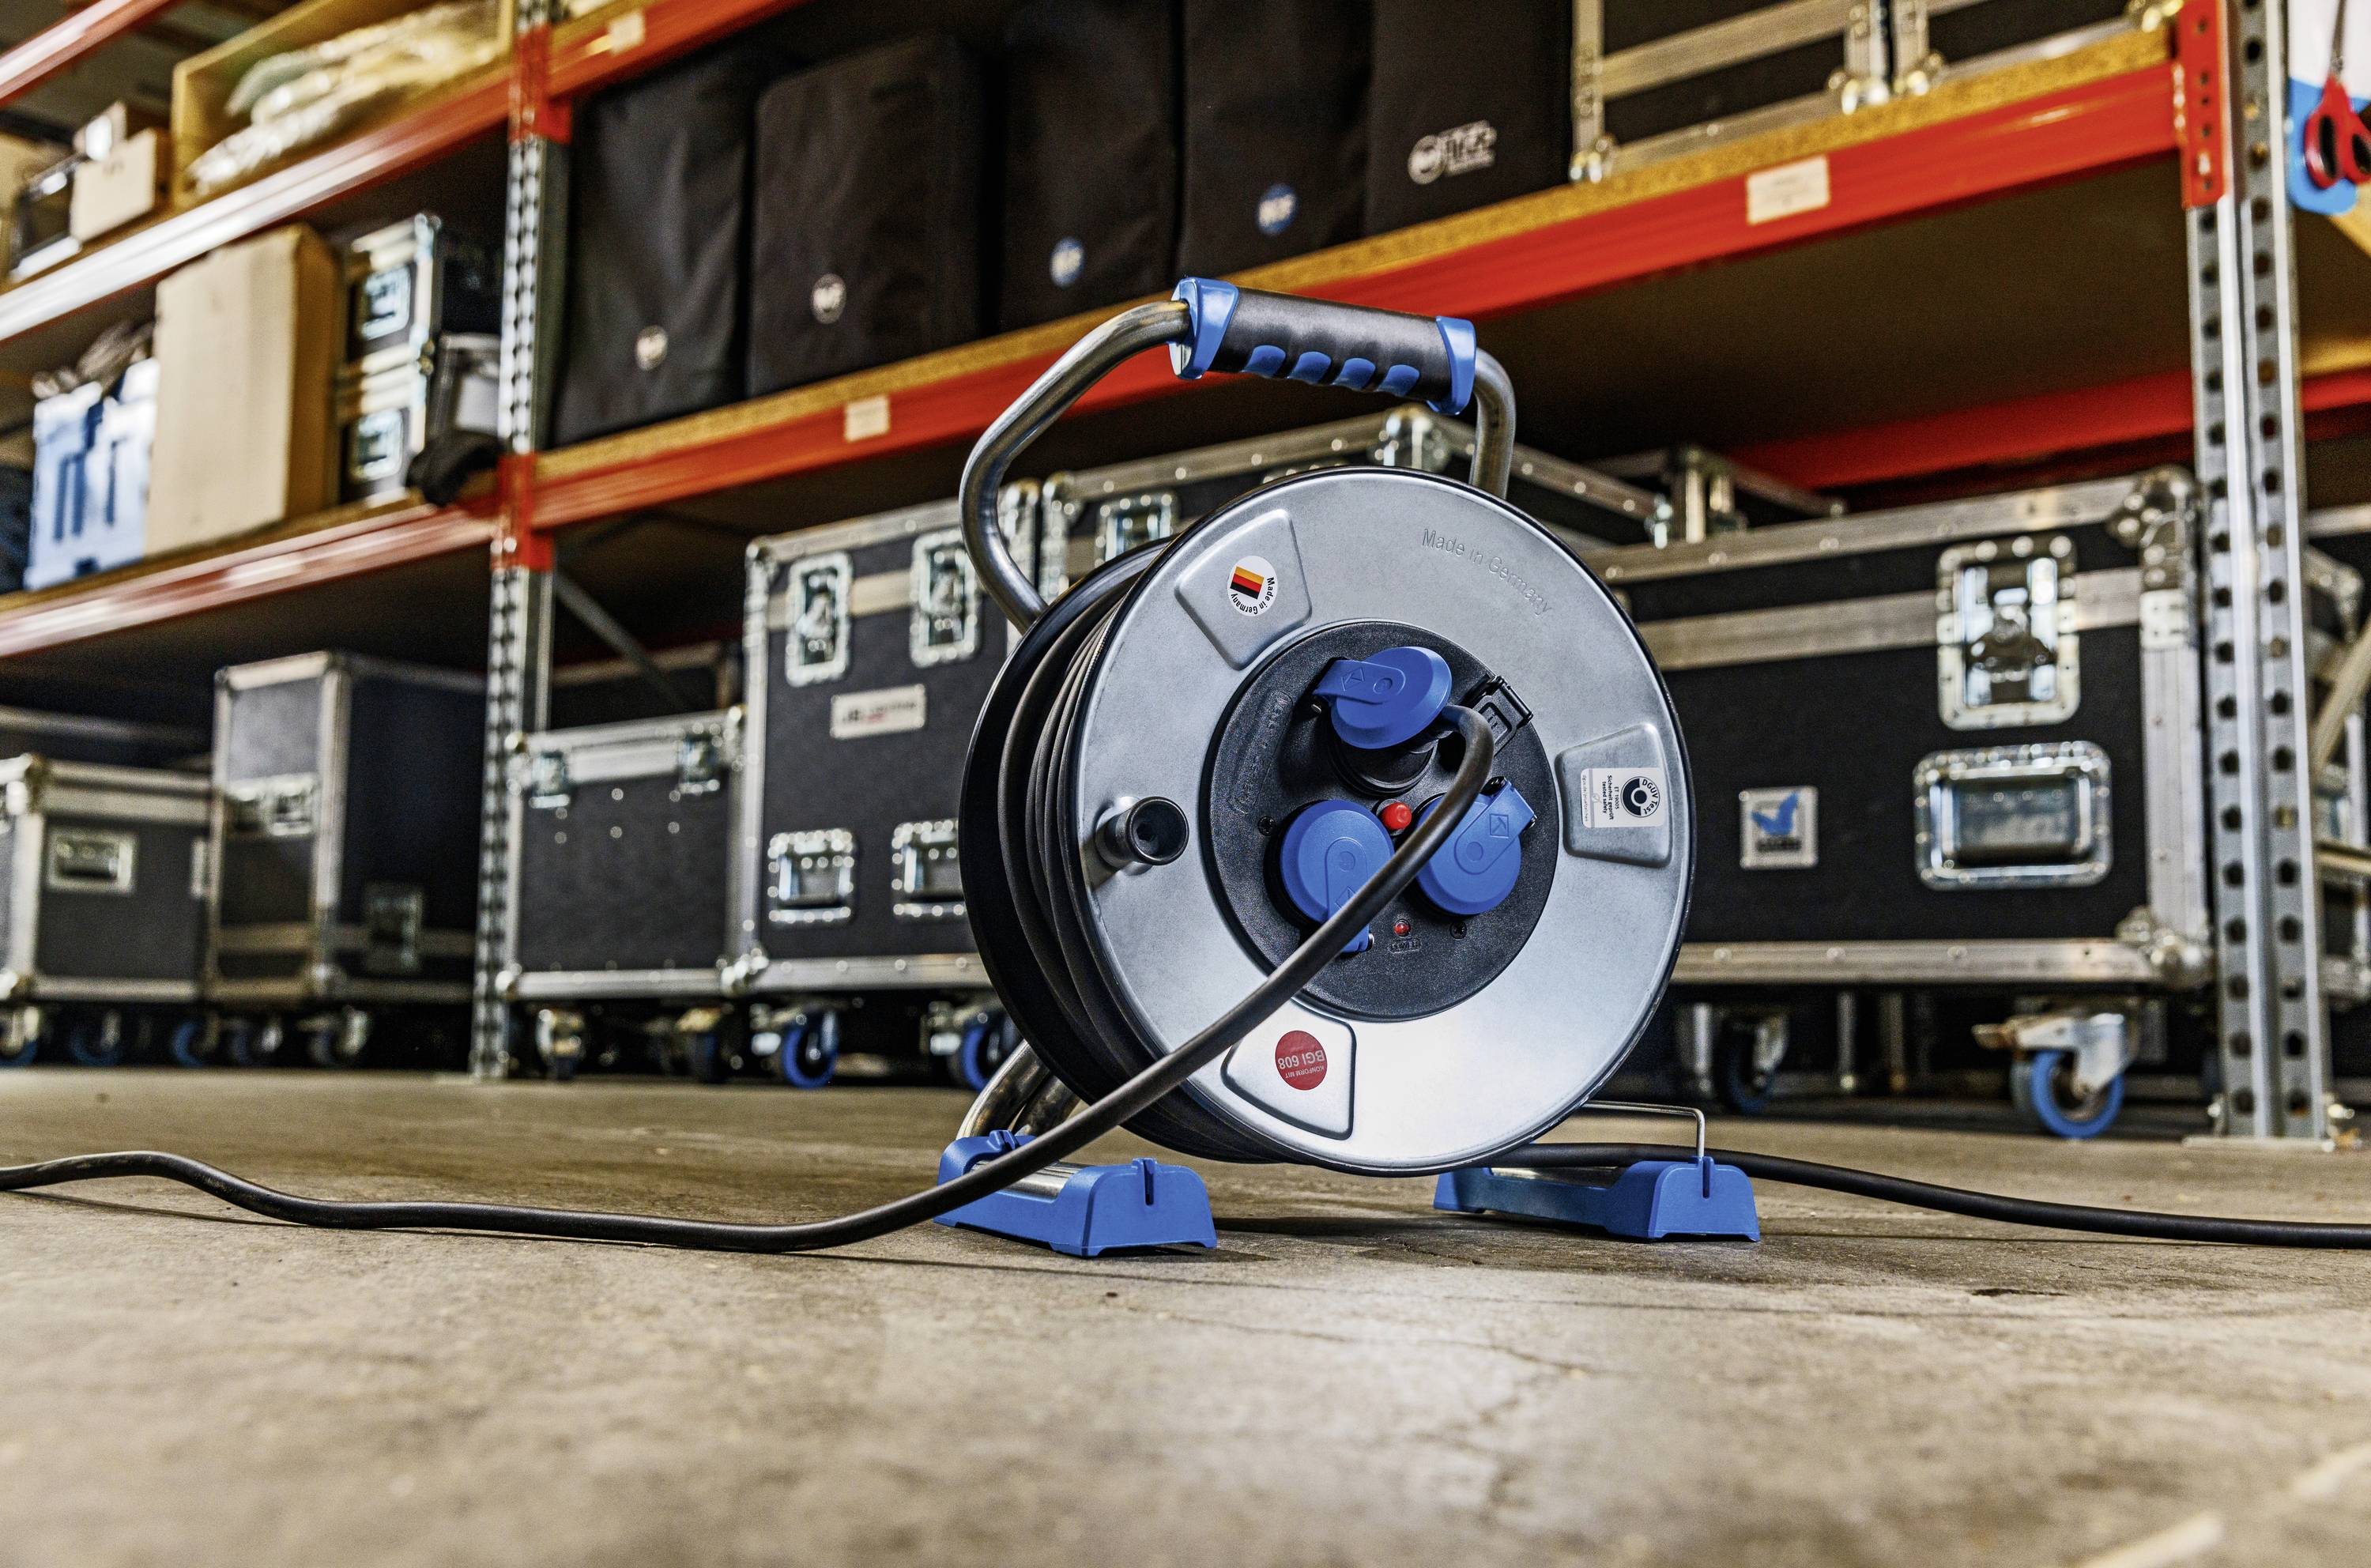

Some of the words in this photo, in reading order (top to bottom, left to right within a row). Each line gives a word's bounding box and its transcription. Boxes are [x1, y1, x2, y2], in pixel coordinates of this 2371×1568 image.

[1423, 529, 1464, 556] Made
[1468, 547, 1484, 566] in
[1488, 557, 1552, 616] Germany
[1265, 577, 1275, 601] Made
[1231, 593, 1258, 615] Germany
[1259, 601, 1268, 609] in
[1642, 778, 1658, 798] DGUV
[1643, 801, 1657, 815] Test
[1278, 1055, 1299, 1069] 608
[1302, 1050, 1325, 1065] BGI
[1296, 1065, 1324, 1076] KONFORM
